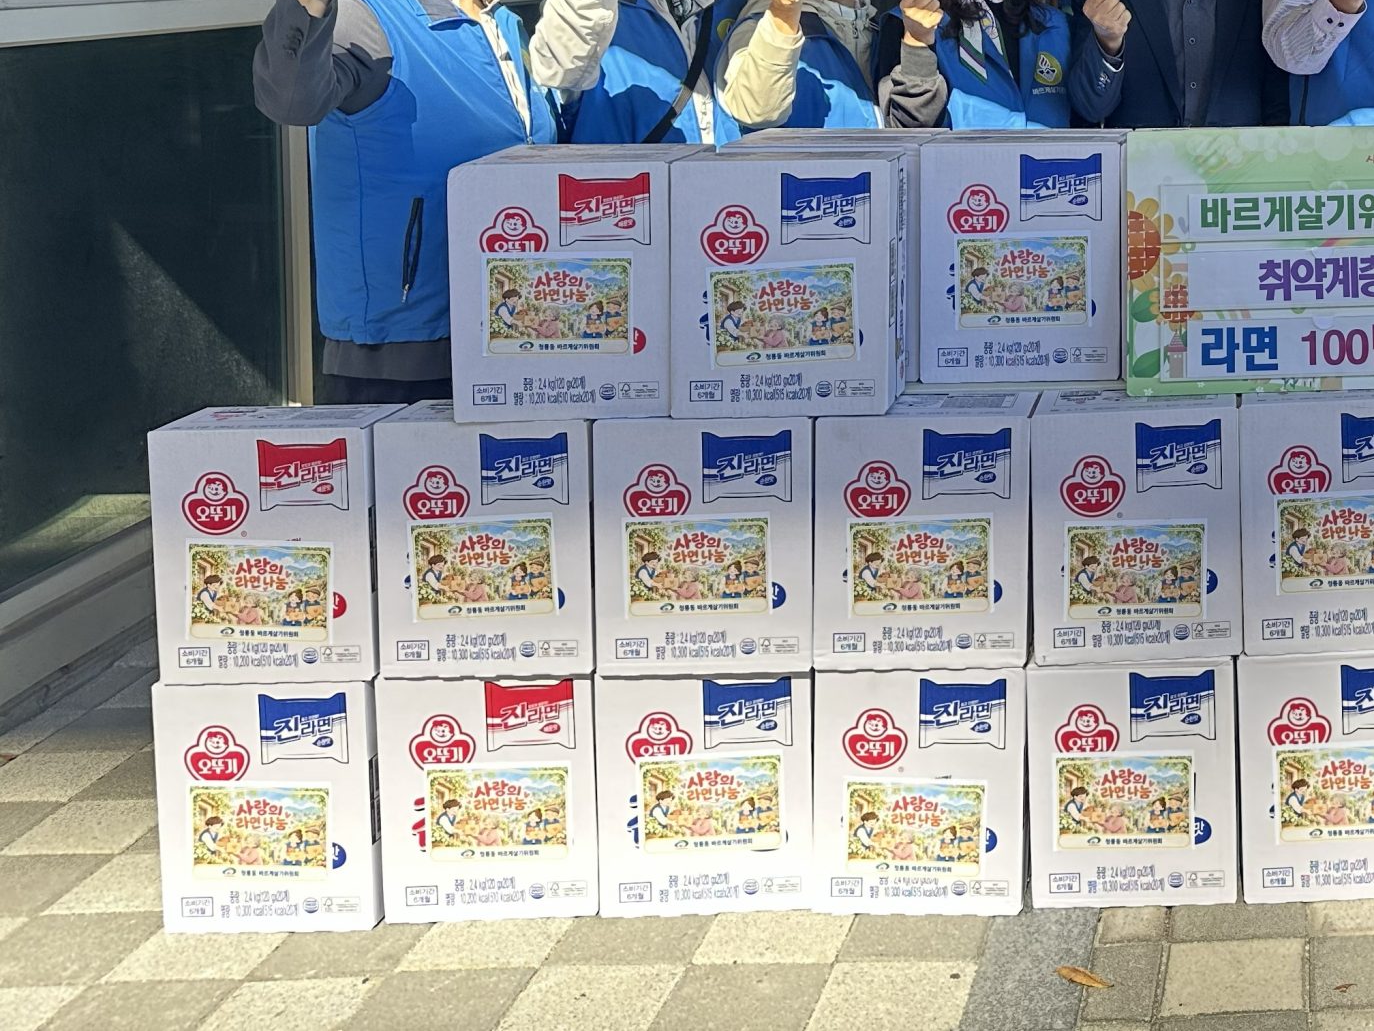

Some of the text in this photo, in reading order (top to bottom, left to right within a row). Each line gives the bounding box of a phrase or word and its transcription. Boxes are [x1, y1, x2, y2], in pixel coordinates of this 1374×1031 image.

[1033, 174, 1088, 199] 진라면
[574, 196, 635, 222] 진라면
[795, 195, 856, 221] 진라면
[960, 216, 997, 230] 오뚜기
[715, 239, 755, 254] 오뚜기
[533, 271, 583, 289] 사랑의
[533, 289, 589, 303] 라면 나눔
[759, 279, 807, 299] 사랑의
[758, 297, 812, 312] 라면 나눔
[1201, 325, 1279, 373] 라면
[936, 450, 997, 477] 진라면
[1150, 443, 1207, 469] 진라면
[495, 455, 554, 481] 진라면
[716, 453, 777, 479] 진라면
[274, 462, 333, 489] 진라면
[858, 494, 898, 510] 오뚜기
[1074, 487, 1112, 504] 오뚜기
[196, 506, 237, 522] 오뚜기
[417, 498, 458, 515] 오뚜기
[637, 497, 678, 514] 오뚜기
[1323, 509, 1367, 526] 사랑의
[674, 532, 721, 549] 사랑의
[1322, 526, 1373, 540] 라면 나눔
[673, 550, 727, 564] 라면 나눔
[236, 558, 283, 575] 사랑의
[235, 575, 289, 591] 라면 나눔
[717, 700, 777, 727] 진라면
[933, 701, 991, 726] 진라면
[1144, 693, 1202, 720] 진라면
[501, 703, 559, 730] 진라면
[273, 715, 333, 741] 진라면
[423, 747, 463, 763] 오뚜기
[855, 741, 895, 757] 오뚜기
[198, 758, 238, 775] 오뚜기
[1101, 769, 1147, 786] 사랑의
[475, 780, 522, 798] 사랑의
[1100, 786, 1152, 799] 라면 나눔
[473, 798, 527, 811] 라면 나눔
